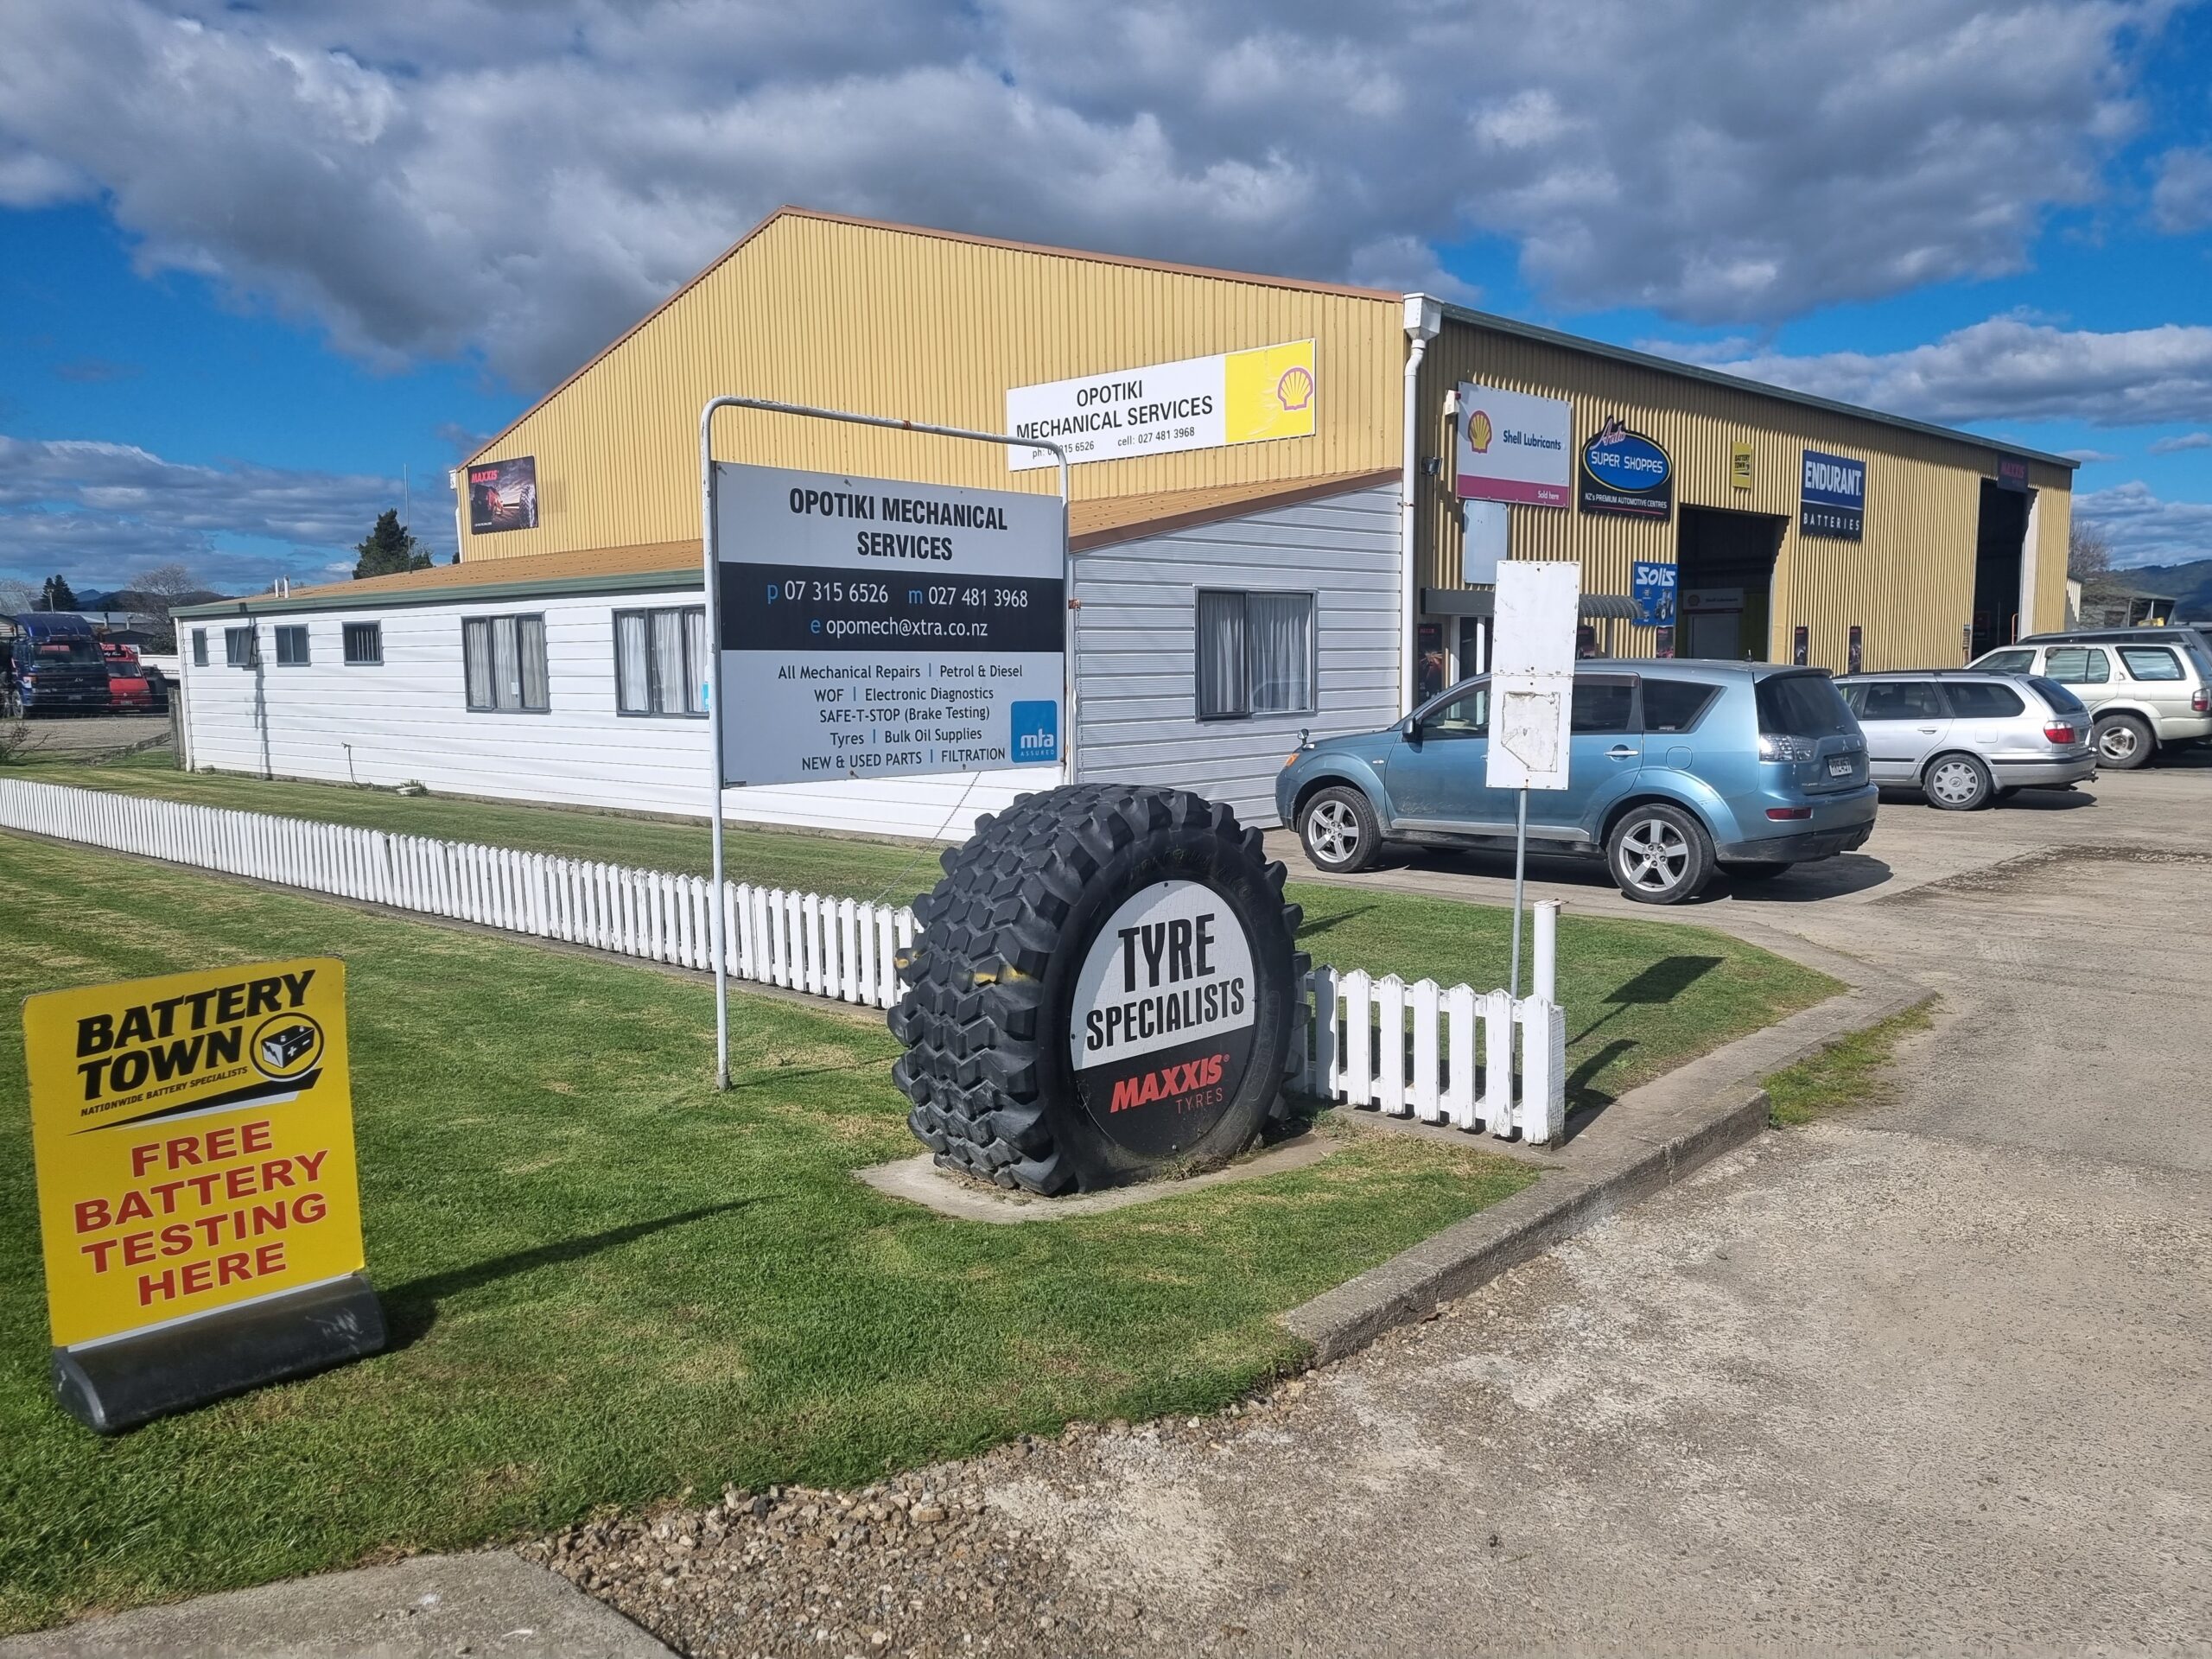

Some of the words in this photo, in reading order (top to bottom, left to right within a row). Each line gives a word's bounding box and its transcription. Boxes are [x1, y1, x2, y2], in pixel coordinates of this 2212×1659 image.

[1077, 380, 1143, 407] OPOTIKI
[1016, 410, 1123, 440] MECHANICAL
[1127, 395, 1213, 426] SERVICES
[1075, 441, 1095, 453] 6526
[1117, 435, 1135, 448] cell:
[1138, 432, 1153, 444] 027
[1155, 429, 1171, 442] 481
[1173, 426, 1195, 440] 3968
[1503, 429, 1522, 445] Shell
[1523, 433, 1562, 450] Lubricants
[1591, 451, 1620, 467] SUPER
[1624, 455, 1663, 474] SHOPPES
[471, 470, 499, 484] MAXXIS
[1537, 490, 1548, 499] Sold
[1548, 491, 1560, 500] here
[1595, 494, 1618, 504] PREMIUM
[1618, 497, 1647, 507] AUTOMOTIVE
[1647, 499, 1668, 509] CENTRES
[789, 487, 875, 520] OPOTIKI
[881, 497, 1008, 531] MECHANICAL
[1803, 512, 1860, 531] BATTERIES
[856, 531, 953, 562] SERVICES
[766, 583, 779, 605] p
[784, 580, 806, 601] 07
[812, 582, 843, 602] 315
[849, 583, 889, 604] 6526
[908, 588, 924, 604] m
[928, 587, 957, 606] 027
[962, 588, 988, 607] 481
[994, 588, 1028, 608] 3968
[810, 619, 821, 634] e
[826, 617, 988, 639] opomech@xtra.co.nz
[778, 665, 796, 680] All
[800, 664, 872, 680] Mechanical
[875, 665, 921, 682] Repairs
[939, 665, 975, 678] Petrol
[978, 665, 986, 678] &
[989, 664, 1023, 678] Diesel
[814, 689, 844, 702] WOF
[865, 688, 926, 702] Electronic
[931, 687, 995, 702] Diagnostics
[819, 709, 900, 723] SAFE-T-STOP
[904, 708, 943, 724] (Brake
[946, 705, 991, 721] Testing)
[830, 733, 865, 749] Tyres
[884, 730, 912, 744] Bulk
[914, 729, 931, 743] Oil
[935, 728, 982, 744] Supplies
[802, 756, 832, 772] NEW
[836, 755, 845, 769] &
[849, 754, 881, 769] USED
[886, 751, 923, 766] PARTS
[941, 747, 1006, 763] FILTRATION
[1117, 912, 1216, 994] TYRE
[76, 969, 316, 1058] BATTERY
[1085, 977, 1245, 1052] SPECIALISTS
[77, 1026, 244, 1101] TOWN
[80, 1093, 144, 1117] NATIONWIDE
[146, 1081, 188, 1101] BATTERY
[189, 1065, 249, 1088] SPECIALISTS
[1176, 1087, 1224, 1115] TYRES
[130, 1120, 273, 1179] FREE
[73, 1149, 329, 1236] BATTERY
[81, 1192, 328, 1274] TESTING
[138, 1242, 287, 1306] HERE
